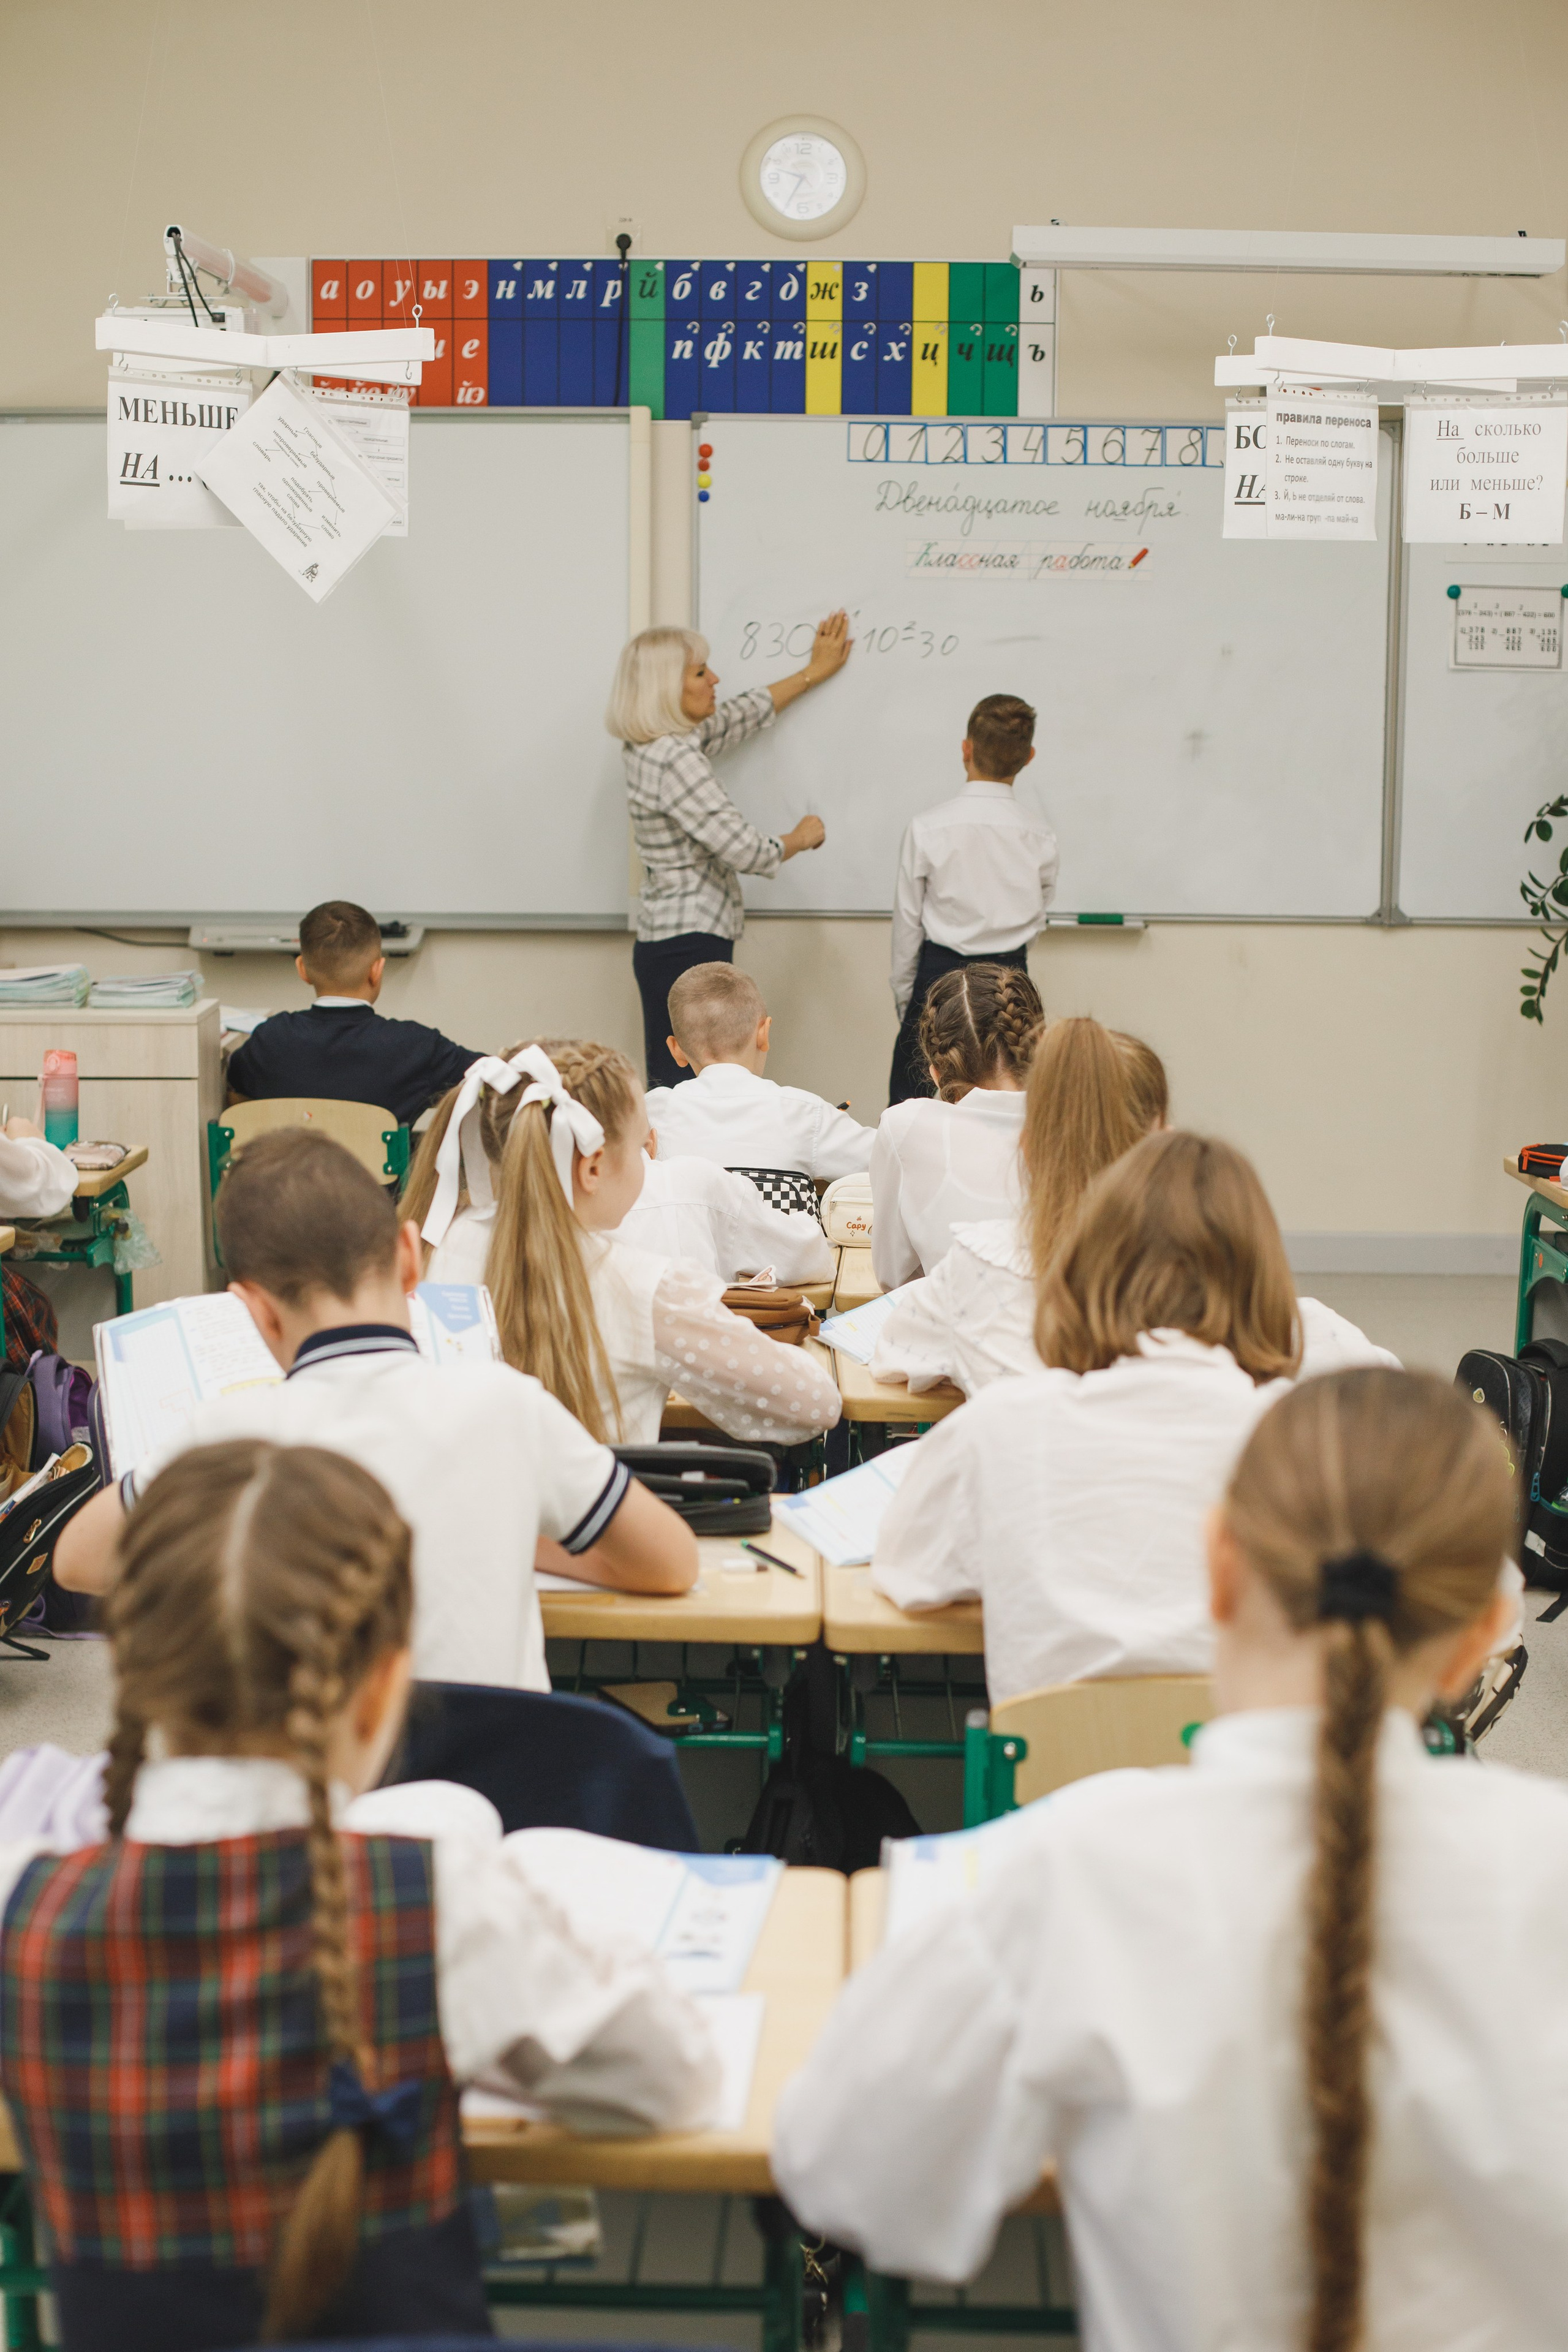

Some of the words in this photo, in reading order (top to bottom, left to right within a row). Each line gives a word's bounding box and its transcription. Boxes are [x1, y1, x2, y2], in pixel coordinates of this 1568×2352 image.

[794, 143, 813, 154] 12
[767, 172, 780, 184] 9
[827, 173, 839, 184] 3
[796, 202, 809, 214] 6
[320, 280, 339, 300] а
[355, 280, 374, 300] о
[389, 279, 412, 307] у
[423, 280, 448, 300] ы
[464, 280, 480, 300] э
[495, 280, 516, 300] н
[527, 280, 555, 300] м
[565, 280, 587, 300] л
[600, 279, 622, 307] р
[638, 271, 657, 299] й
[672, 272, 693, 300] б
[709, 281, 727, 300] в
[779, 273, 799, 301] д
[810, 281, 840, 301] ж
[853, 281, 869, 301] з
[462, 339, 480, 359] е
[672, 339, 694, 360] п
[704, 331, 731, 368] ф
[742, 340, 764, 360] к
[774, 341, 804, 360] т
[809, 341, 837, 360] ш
[850, 341, 869, 361] с
[883, 341, 907, 361] х
[921, 342, 938, 366] ц
[956, 342, 974, 361] ч
[986, 342, 1015, 368] щ
[1028, 344, 1046, 362] ъ
[118, 396, 238, 429] МЕНЬШЕ
[1276, 413, 1322, 424] правила
[1325, 416, 1371, 428] переноса
[278, 417, 298, 438] ударные
[303, 427, 322, 449] Гласные
[1438, 420, 1459, 436] На
[1475, 423, 1542, 436] сколько
[252, 441, 271, 462] словарь
[273, 429, 307, 469] непроверяемые
[862, 424, 886, 461] 0
[907, 426, 927, 462] 1
[941, 426, 963, 463] 2
[981, 426, 1005, 463] 3
[1023, 427, 1044, 464] 4
[1061, 428, 1084, 464] 5
[1102, 428, 1125, 464] 6
[1141, 429, 1162, 465] 7
[1179, 428, 1203, 466] 8
[1276, 435, 1282, 445] 1.
[1286, 435, 1319, 448] Переноси
[310, 451, 336, 480] безударные
[1276, 454, 1281, 463] 2.
[1285, 455, 1294, 464] Не
[1296, 456, 1327, 466] оставляй
[1329, 459, 1344, 469] одну
[1346, 458, 1363, 469] букву
[1457, 447, 1520, 464] больше
[119, 453, 159, 480] НА
[290, 477, 313, 503] подобрать
[1284, 475, 1308, 484] строке.
[1430, 478, 1460, 491] или
[1471, 475, 1544, 491] меньше?
[282, 478, 313, 513] однокоренные
[287, 493, 300, 508] слова
[317, 481, 345, 513] проверяемые
[1275, 491, 1280, 500] 3.
[1284, 489, 1291, 501] Й,
[1308, 493, 1335, 503] отделяй
[252, 487, 272, 508] гласную
[271, 507, 288, 526] падало
[287, 524, 307, 548] ударение
[267, 491, 281, 508] чтобы
[287, 513, 312, 542] безударную
[1275, 513, 1305, 522] ма-ли-на
[1336, 514, 1359, 524] май-ка
[1459, 503, 1471, 519] Б
[1493, 503, 1511, 519] М
[321, 524, 334, 540] слово
[322, 514, 341, 538] изменить
[914, 541, 1020, 568] Классная
[1031, 543, 1124, 580] работа
[739, 621, 818, 660] 830
[846, 1221, 866, 1231] Capy
